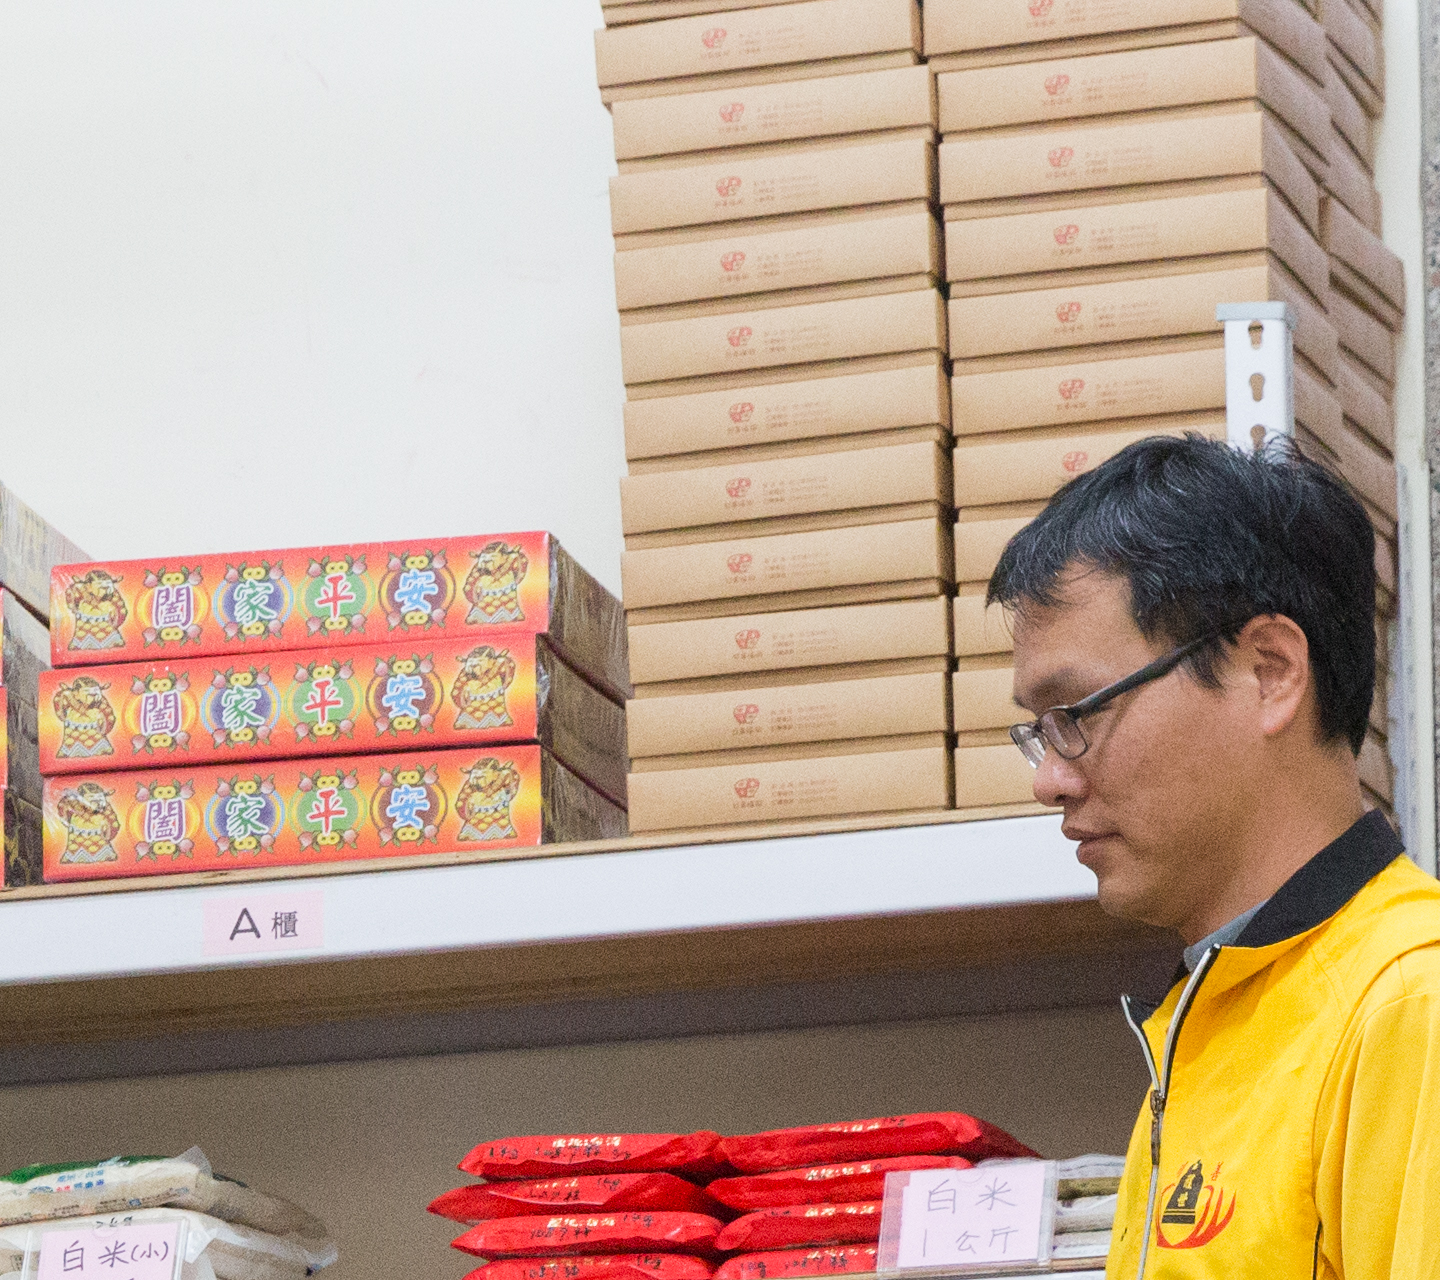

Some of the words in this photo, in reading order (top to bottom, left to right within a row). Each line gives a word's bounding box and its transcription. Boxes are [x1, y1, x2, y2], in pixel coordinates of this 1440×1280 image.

[154, 570, 440, 631] 闔家平安
[140, 674, 428, 737] 闔家平安
[145, 786, 431, 844] 闔家平安
[928, 1178, 1016, 1214] 白米
